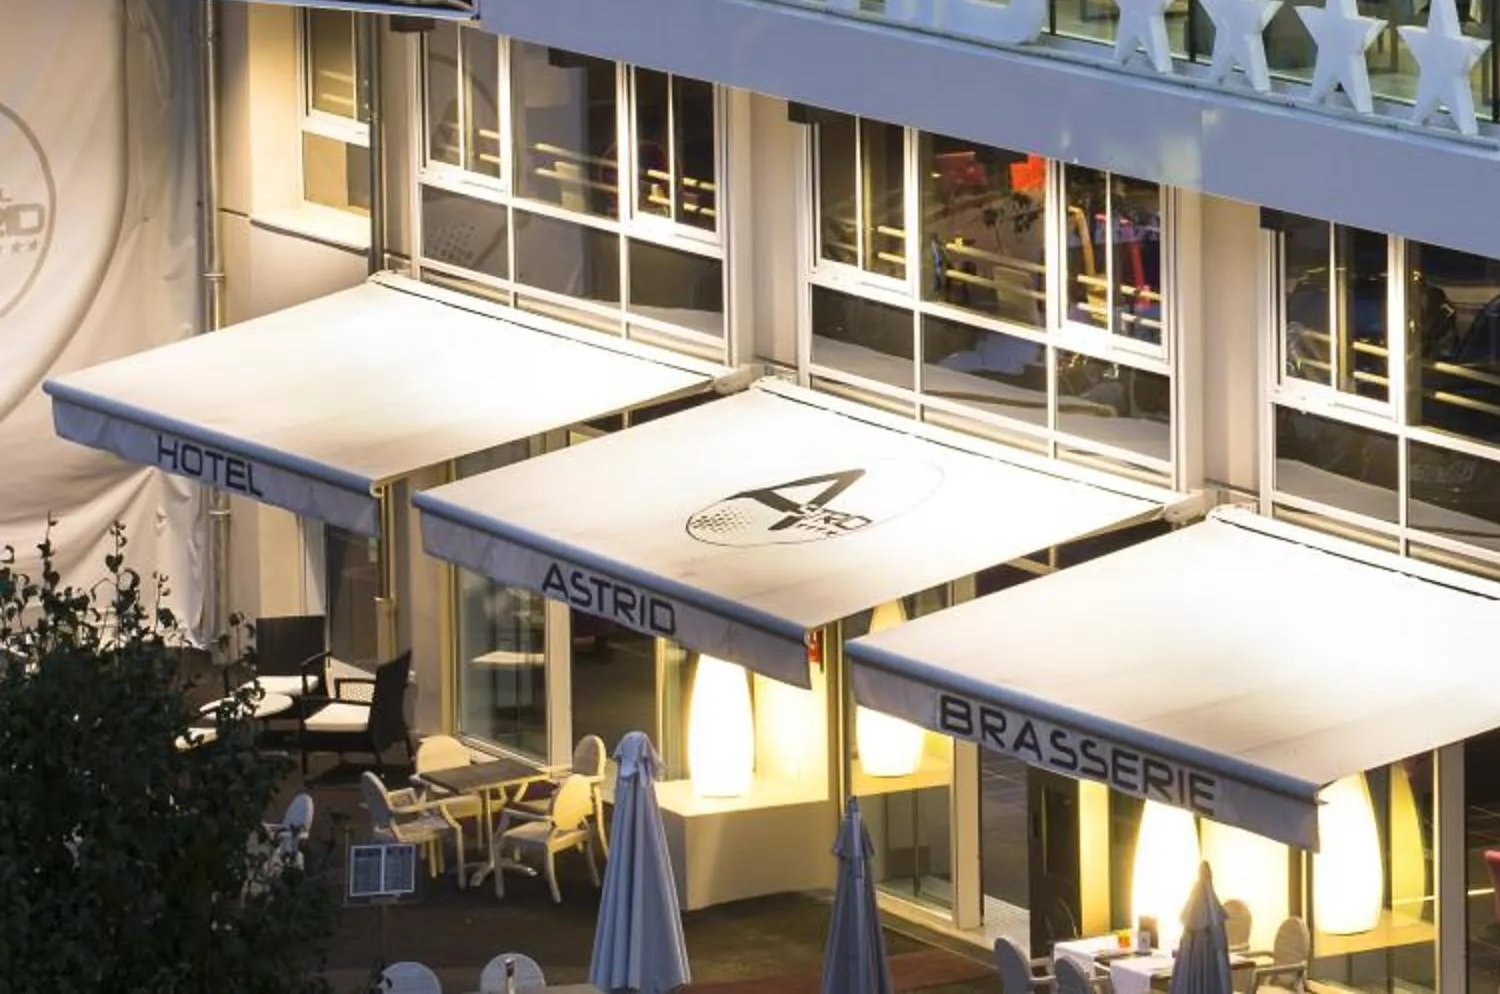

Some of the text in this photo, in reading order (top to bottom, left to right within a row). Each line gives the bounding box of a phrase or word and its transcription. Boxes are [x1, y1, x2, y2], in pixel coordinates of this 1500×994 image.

[157, 434, 264, 498] HOTEL
[541, 561, 677, 636] ASTRID
[939, 694, 1216, 817] BRASSERIE
